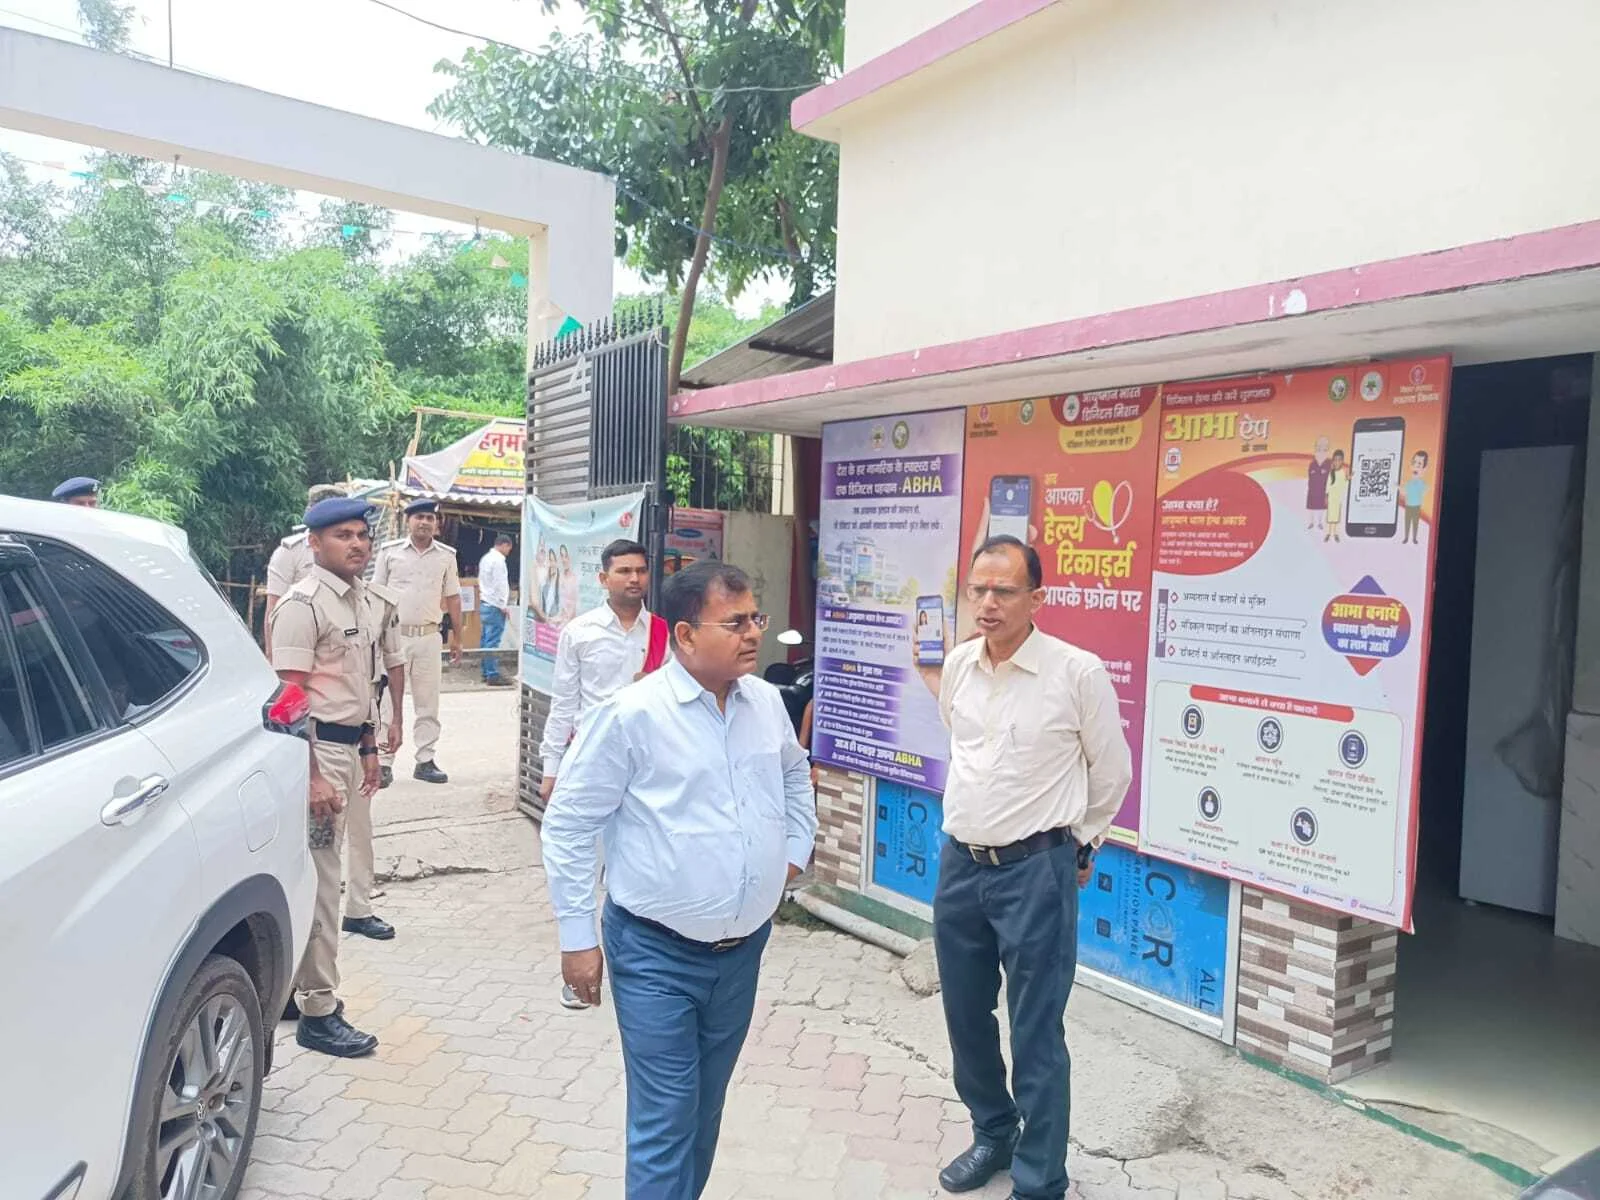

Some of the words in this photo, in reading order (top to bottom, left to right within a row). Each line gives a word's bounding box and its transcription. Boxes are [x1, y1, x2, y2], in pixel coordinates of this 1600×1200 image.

[1164, 411, 1239, 441] आभा
[1239, 413, 1270, 440] ऐप
[902, 476, 942, 493] ABHA
[1045, 488, 1085, 505] आपका
[1044, 507, 1086, 545] हेल्थ
[1120, 590, 1143, 612] पर
[1331, 602, 1362, 619] आभा
[894, 751, 923, 768] ABHA
[1131, 857, 1142, 916] ARTITION
